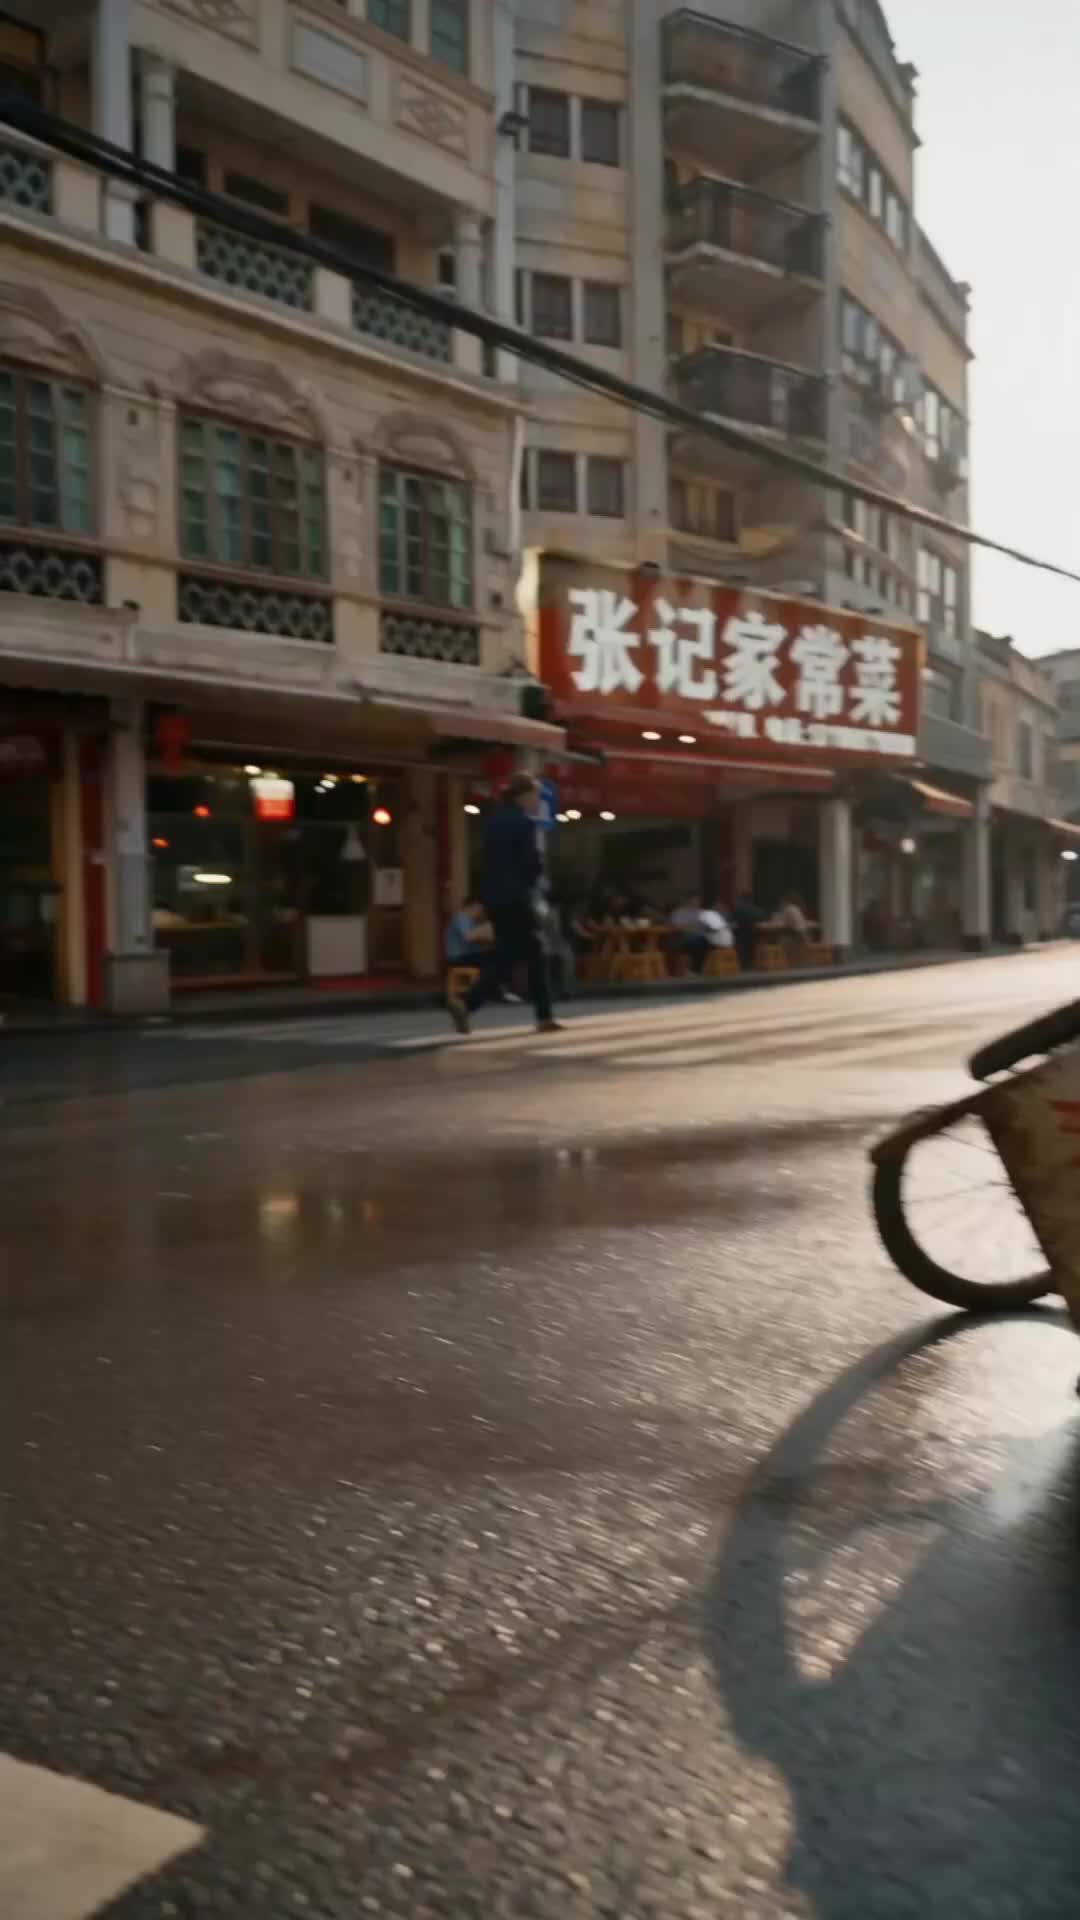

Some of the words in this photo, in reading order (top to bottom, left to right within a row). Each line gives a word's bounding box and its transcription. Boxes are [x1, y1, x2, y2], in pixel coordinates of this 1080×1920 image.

[568, 588, 902, 726] 张记家常菜
